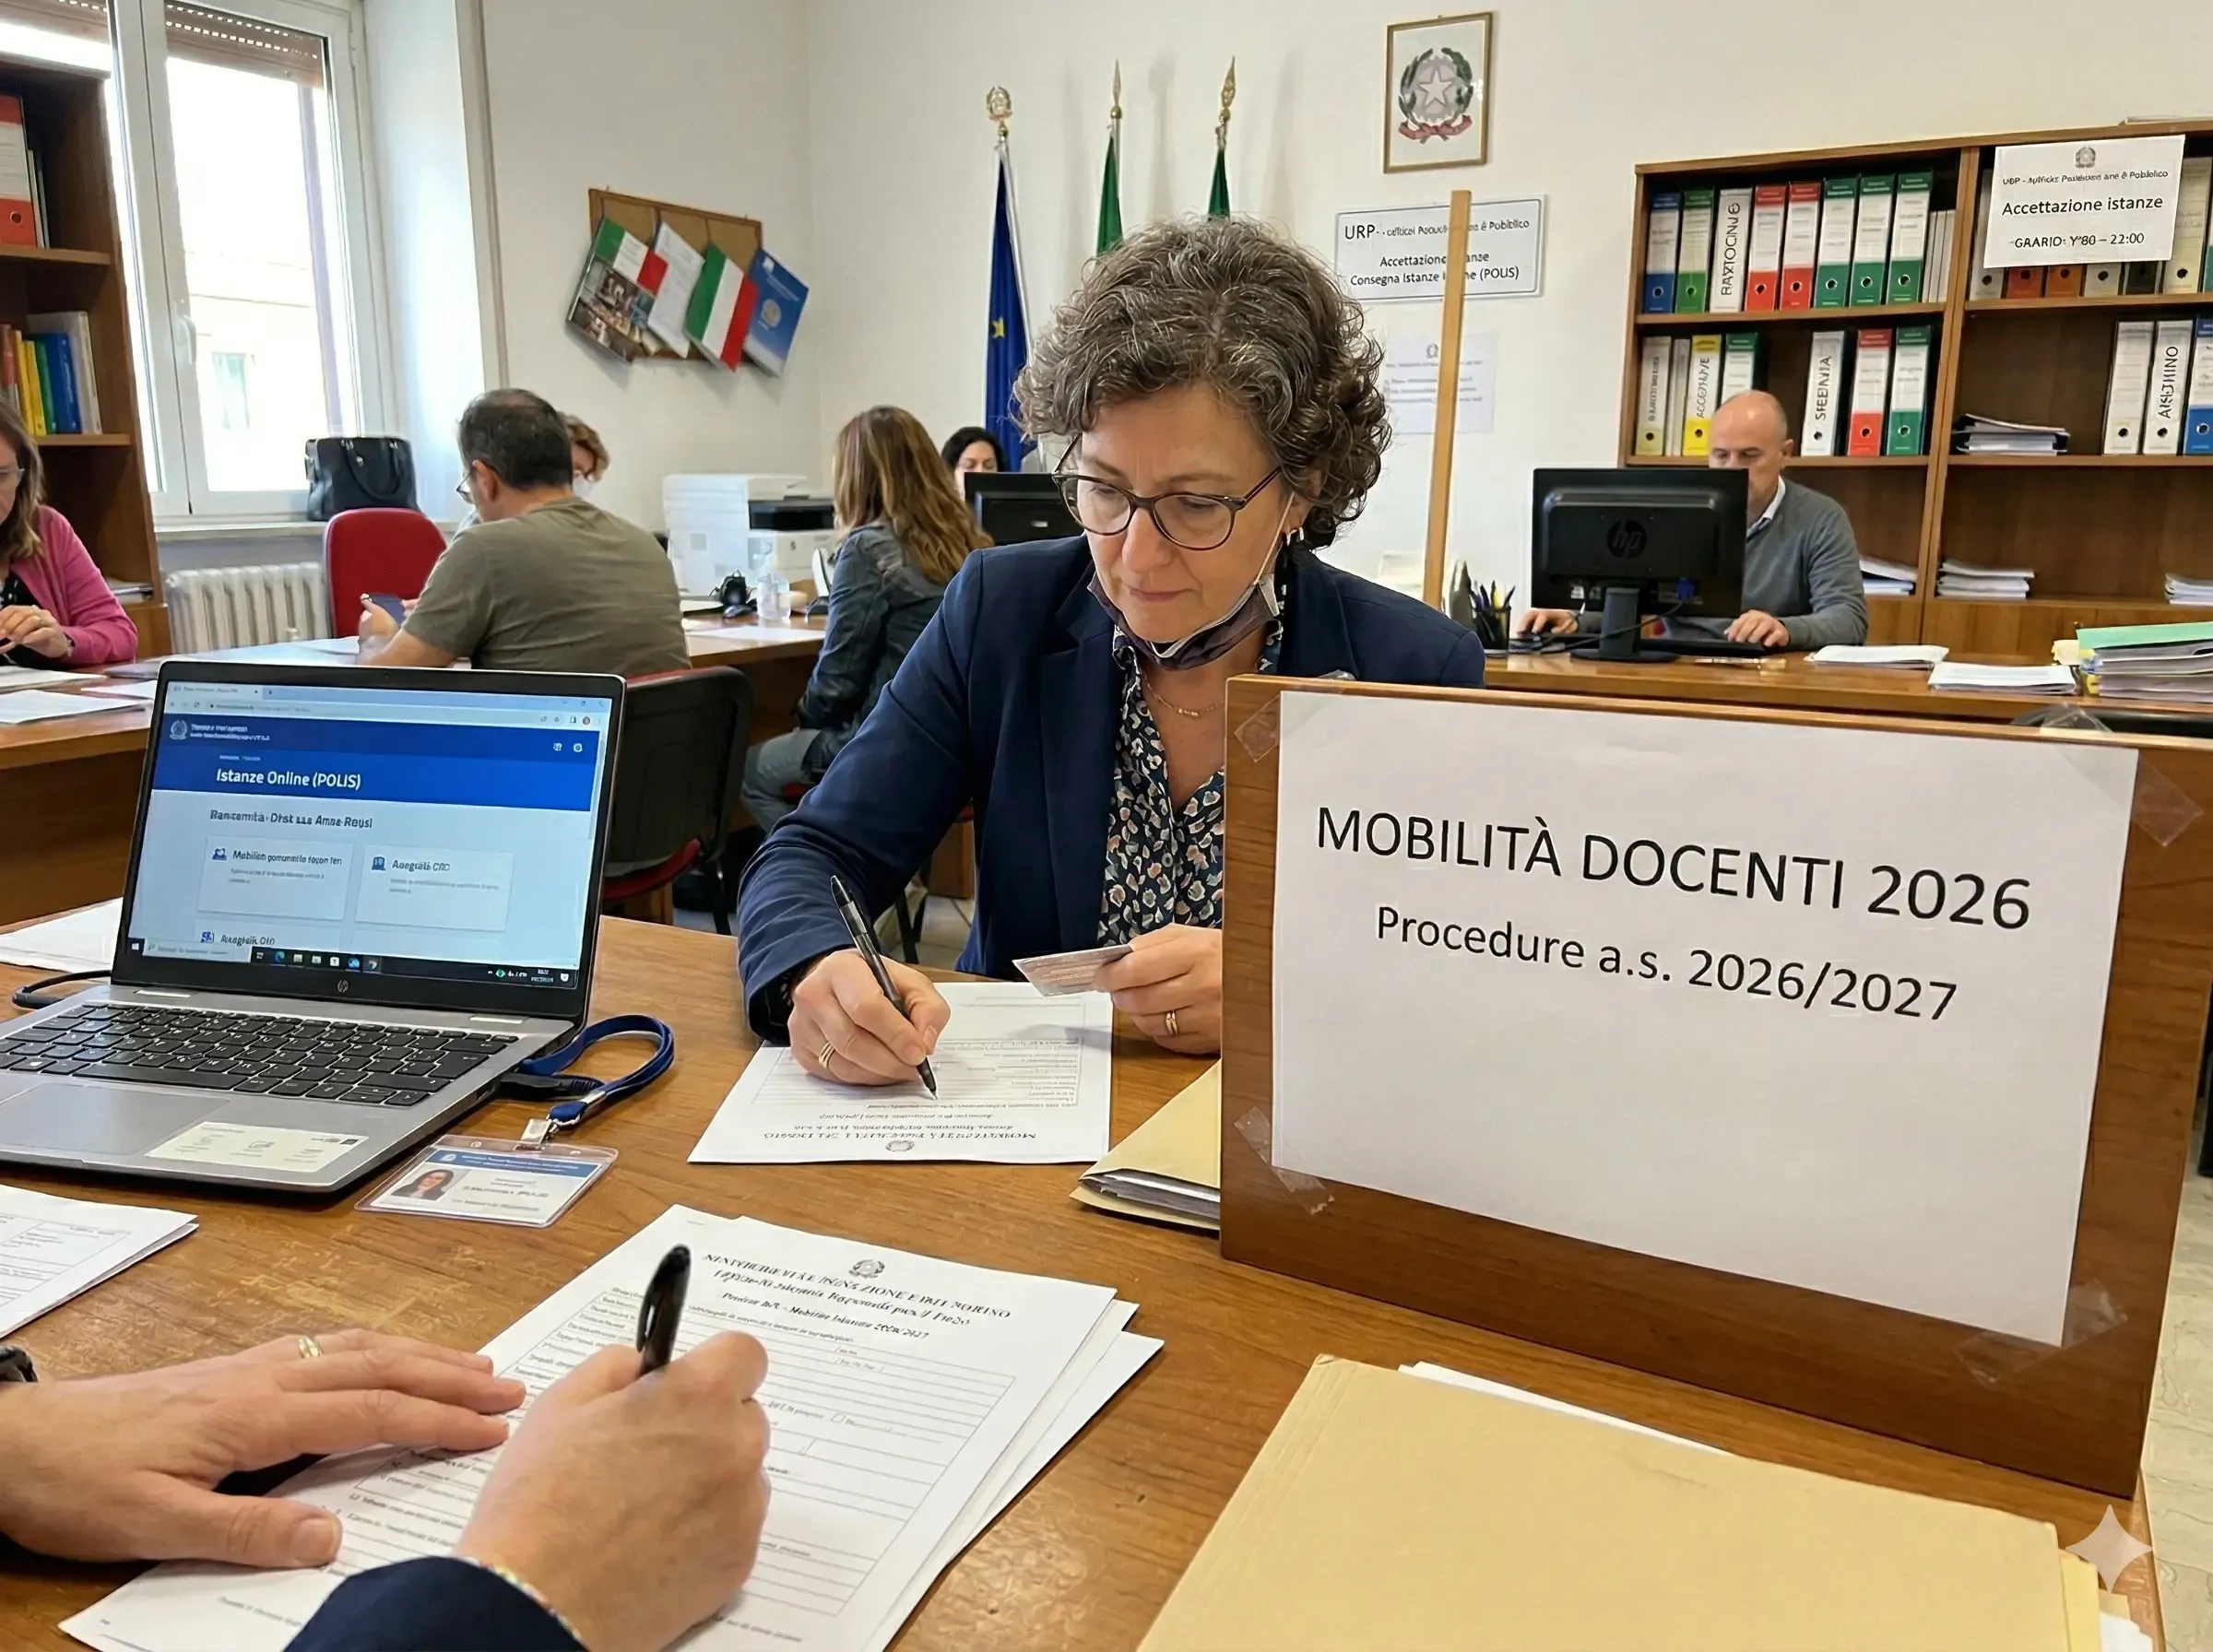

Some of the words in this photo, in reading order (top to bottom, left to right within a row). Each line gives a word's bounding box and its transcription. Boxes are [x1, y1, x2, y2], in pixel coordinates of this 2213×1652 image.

[2002, 198, 2102, 216] Accettazione
[2107, 196, 2163, 210] istanze
[2110, 232, 2145, 245] 22:00
[1350, 274, 1400, 287] Consegna
[1402, 271, 1439, 283] Istanze
[216, 768, 266, 785] Istanze
[266, 771, 314, 786] Online
[313, 772, 361, 790] (POLIS)
[1319, 807, 1561, 876] MOBILITÀ
[1582, 834, 1843, 909] DOCENTI
[1867, 865, 2030, 929] 2026
[1379, 906, 1585, 968] Procedure
[1599, 945, 1671, 982] a.s.
[1688, 950, 1957, 1021] 2026/2027
